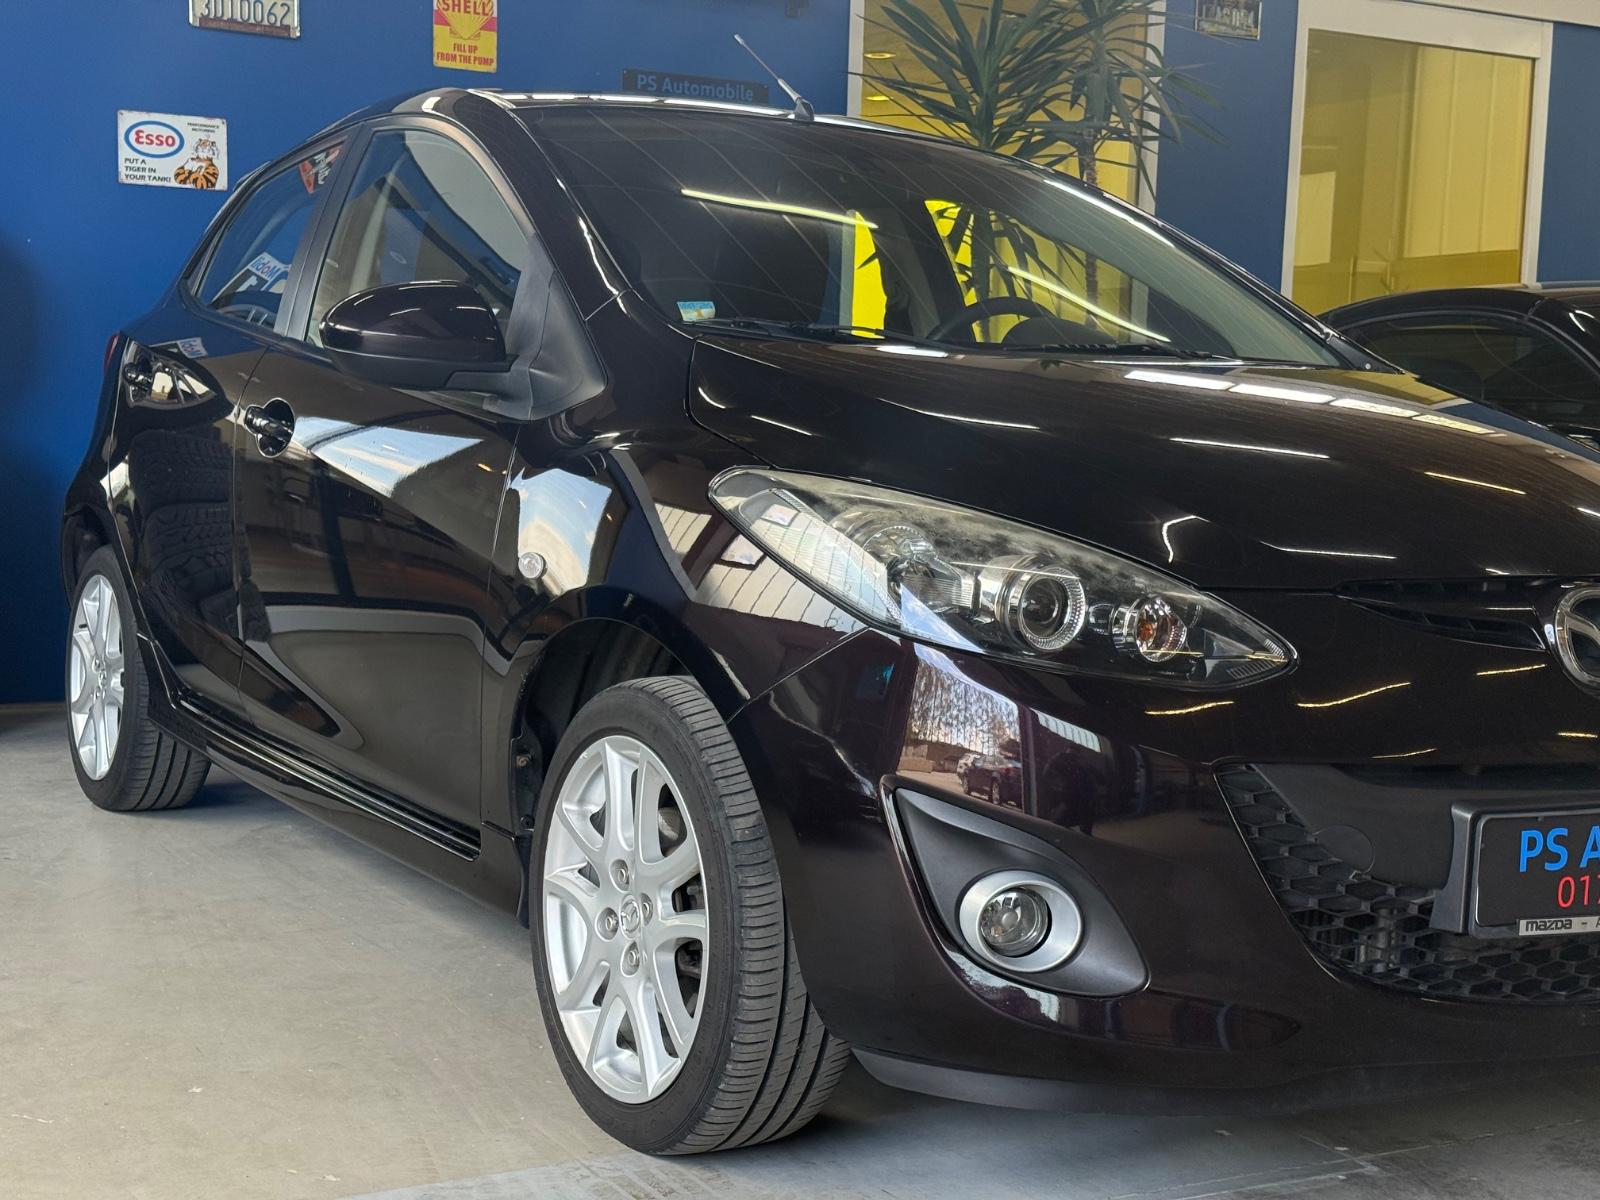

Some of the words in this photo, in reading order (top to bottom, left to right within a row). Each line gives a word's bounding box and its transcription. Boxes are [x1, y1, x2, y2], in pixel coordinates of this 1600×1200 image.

[441, 0, 490, 16] SHELL
[453, 43, 466, 53] FILL
[467, 45, 478, 54] UP
[436, 52, 457, 62] FROM
[458, 54, 472, 64] THE
[473, 56, 494, 66] PUMP
[637, 74, 657, 91] PS
[662, 77, 754, 101] Automobile
[124, 157, 139, 165] PUT
[124, 165, 147, 173] TIGER
[124, 173, 146, 181] YOUR
[148, 175, 172, 183] TANK!
[1519, 827, 1569, 873] PS
[1557, 875, 1600, 908] 01
